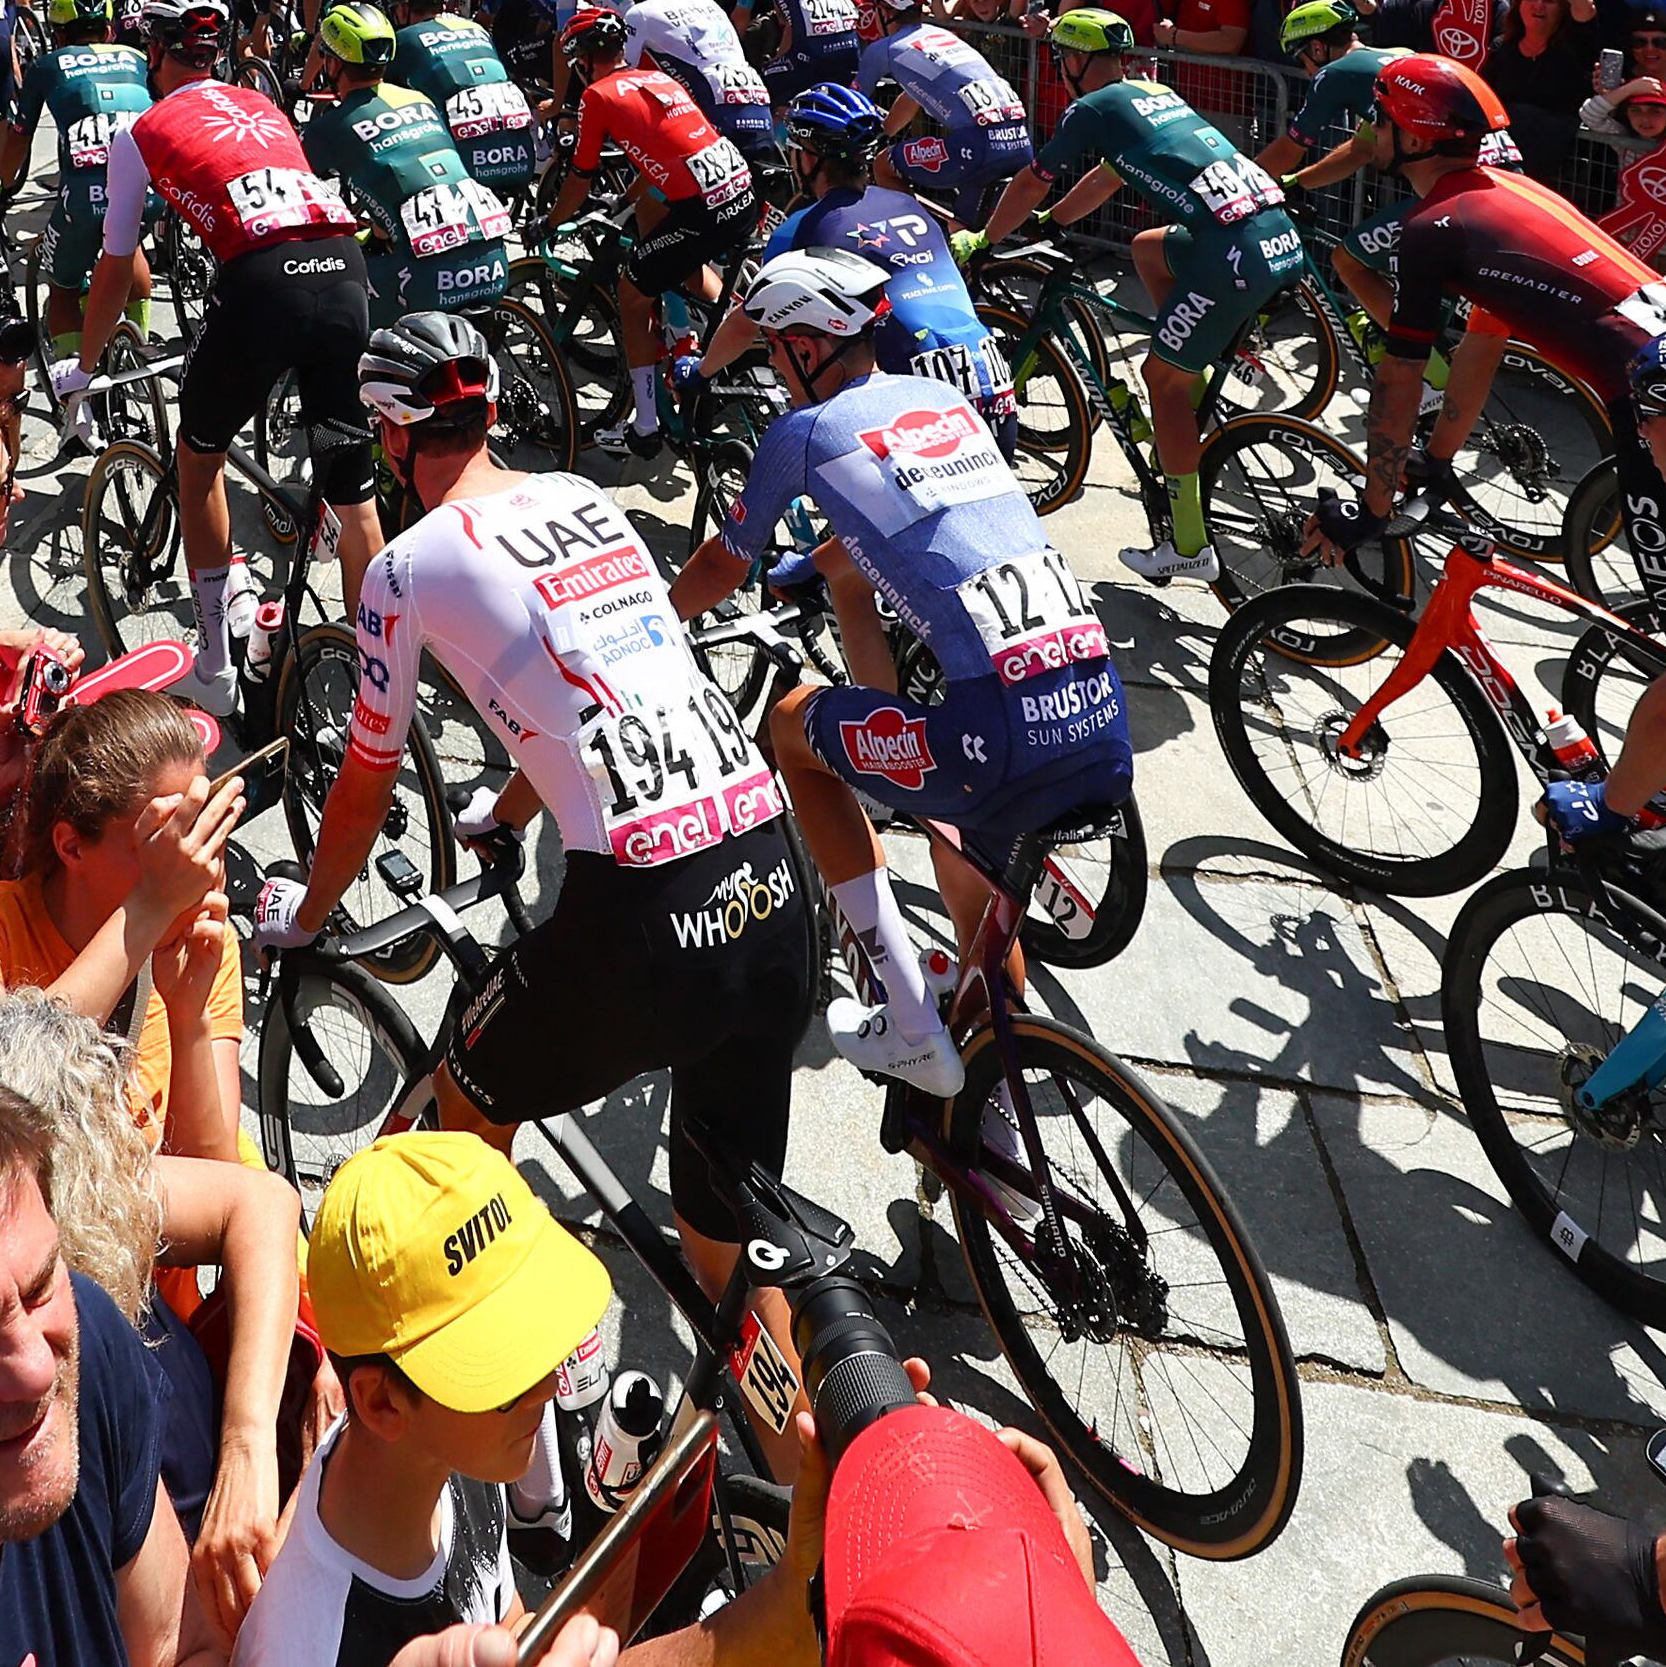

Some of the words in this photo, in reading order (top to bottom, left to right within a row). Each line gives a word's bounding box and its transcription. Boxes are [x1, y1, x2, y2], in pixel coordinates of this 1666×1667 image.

[419, 28, 491, 48] BORA
[58, 51, 137, 70] BORA
[64, 63, 138, 80] hansgrohe
[456, 89, 483, 118] 45
[1395, 74, 1426, 96] KASK
[78, 116, 103, 145] 41
[352, 102, 439, 142] BORA
[371, 122, 443, 154] hansgrohe
[472, 145, 529, 165] BORA
[618, 138, 671, 186] ARKEA
[909, 143, 942, 160] Alpecin
[241, 169, 286, 209] 54
[475, 164, 529, 179] hansgrohe
[695, 153, 728, 189] 28
[1115, 153, 1195, 214] hansgrohe
[715, 192, 756, 225] ARKEA
[652, 232, 685, 252] HOTELS
[1259, 228, 1301, 260] BORA
[284, 256, 346, 275] Cofidis
[437, 260, 505, 291] BORA
[438, 284, 504, 306] hansgrohe
[1477, 267, 1584, 306] GRENADIER
[766, 294, 813, 324] CANYON
[1158, 290, 1216, 352] BORA
[393, 335, 420, 356] MET
[914, 346, 974, 396] 107
[1234, 363, 1255, 385] 46
[1503, 353, 1576, 395] oval
[881, 412, 968, 450] Alpecin
[893, 448, 1000, 491] deceuninck
[495, 504, 625, 568] UAE
[544, 551, 648, 601] Emirates
[1156, 558, 1210, 575] SPECIALIZED
[592, 590, 654, 620] COLNAGO
[842, 533, 932, 641] deceuninck
[977, 564, 1042, 639] 12
[1482, 568, 1563, 606] PINARELLO
[602, 636, 651, 668] ADNOC
[1004, 640, 1067, 684] enel
[1020, 670, 1114, 724] BRUSTOR
[488, 697, 522, 736] FAB
[1027, 725, 1064, 746] SUN
[1068, 697, 1121, 743] SYSTEMS
[586, 702, 701, 817] 194
[855, 725, 920, 767] Alpecin
[624, 817, 709, 865] enel
[669, 858, 795, 949] WHOOSH
[1042, 880, 1080, 935] 12
[460, 969, 507, 1036] #WeAreUAE
[749, 1338, 798, 1431] 194
